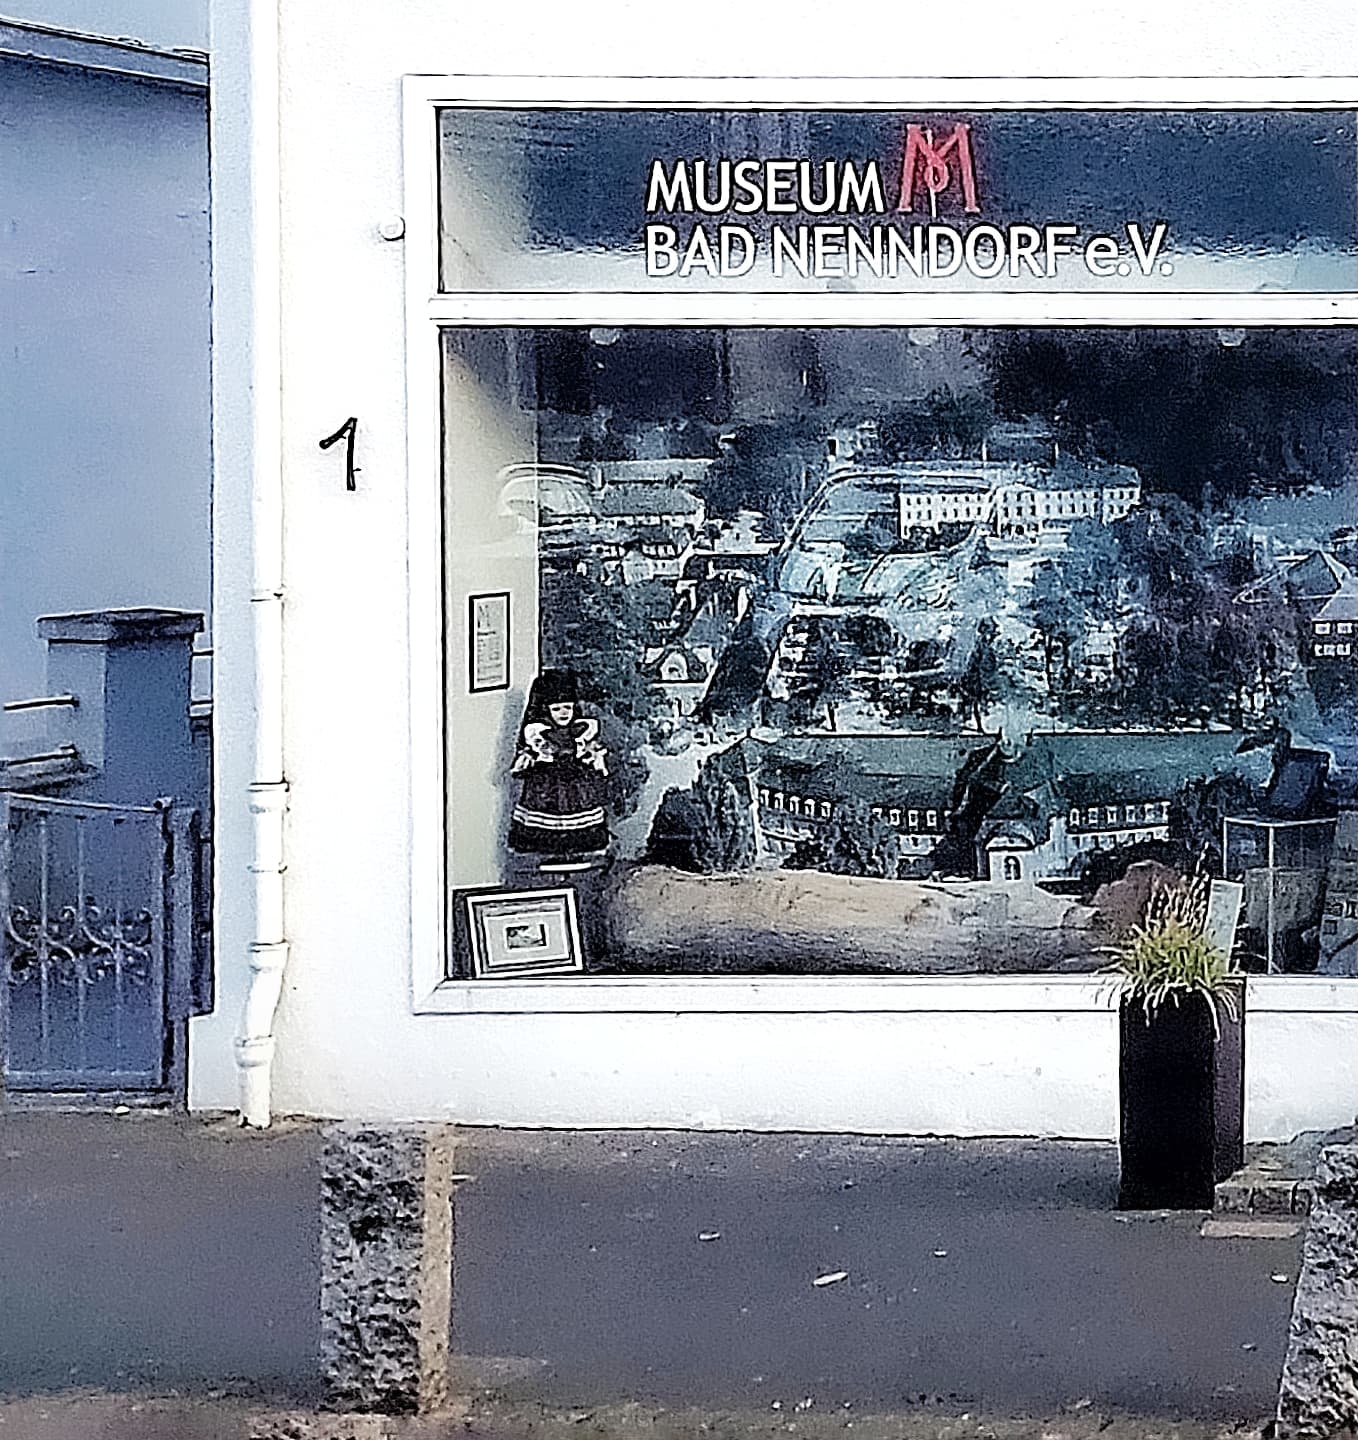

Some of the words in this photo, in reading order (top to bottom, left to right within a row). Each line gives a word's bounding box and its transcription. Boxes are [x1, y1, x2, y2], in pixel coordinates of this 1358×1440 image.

[646, 159, 885, 212] MUSEUM
[646, 225, 756, 278] BAD
[774, 224, 1078, 278] NENNDORF
[1084, 224, 1174, 277] e.V.
[319, 417, 361, 491] 1
